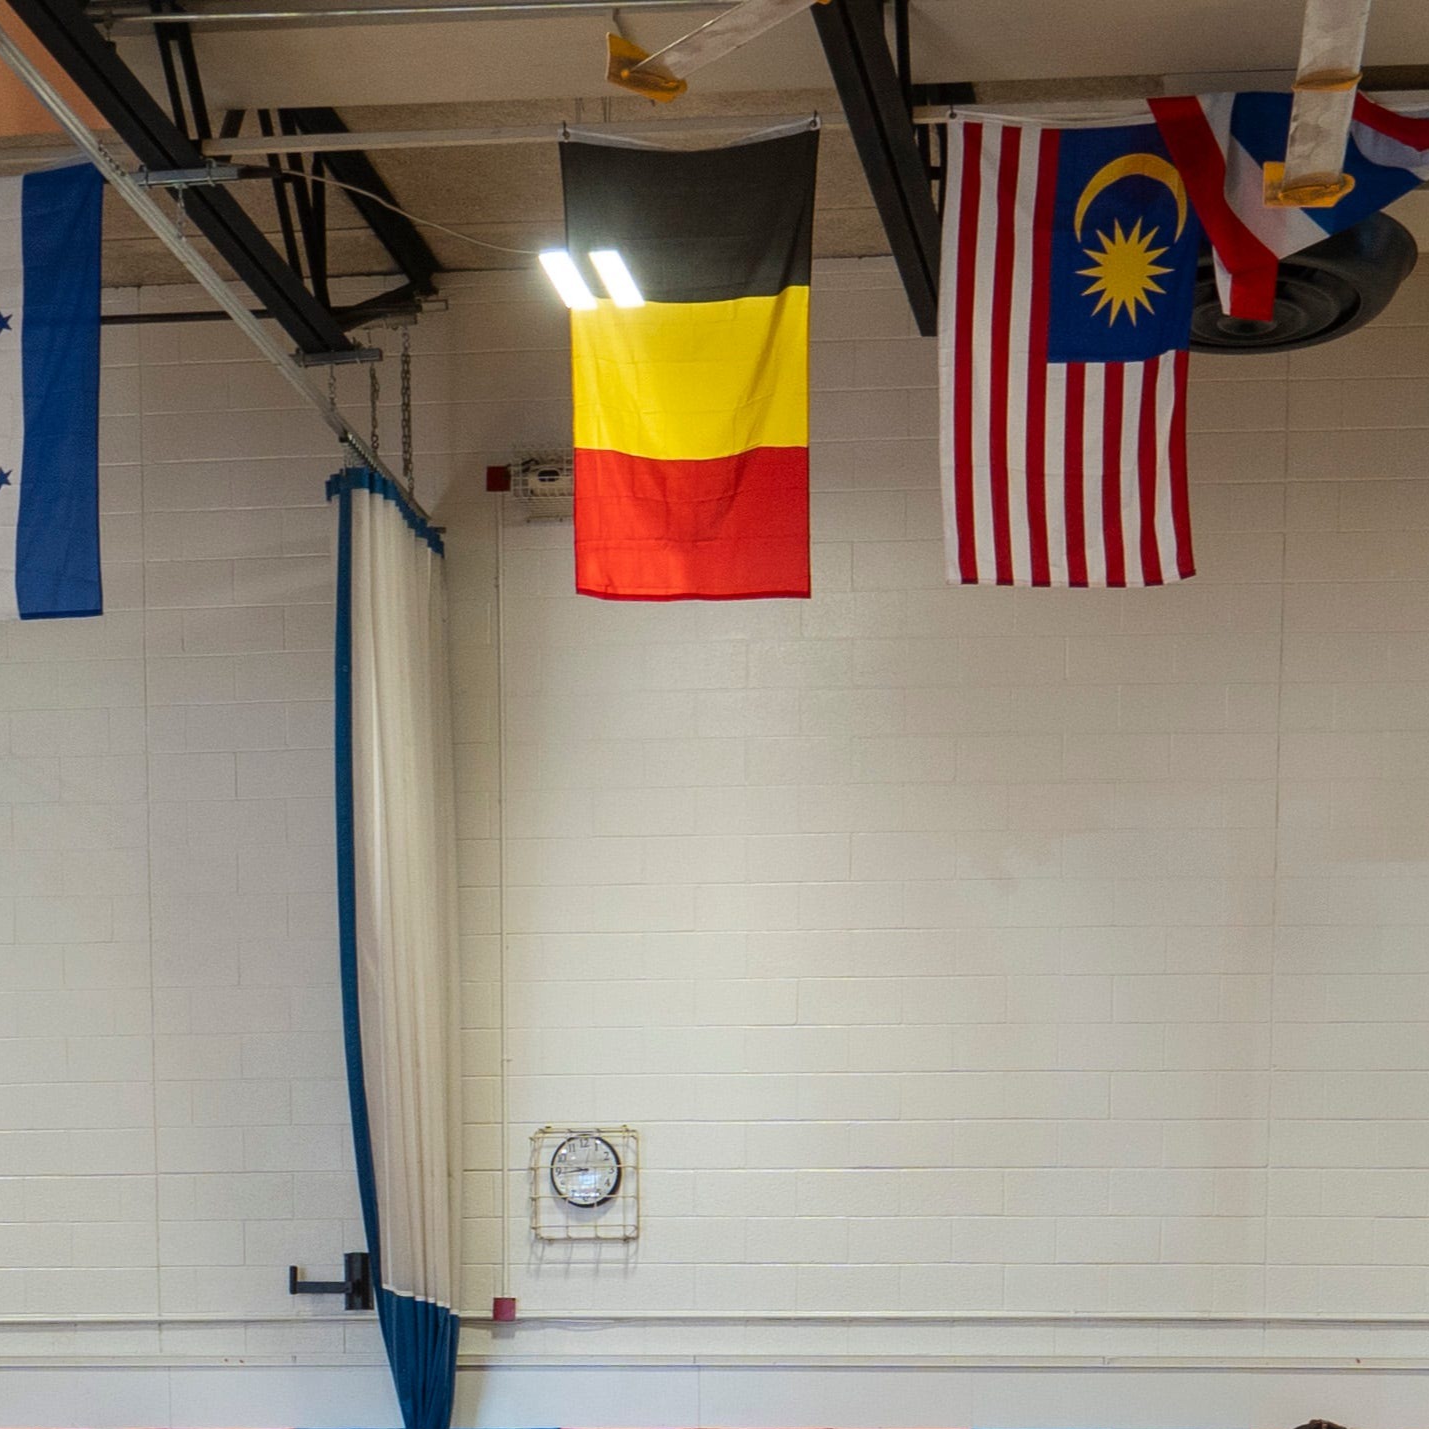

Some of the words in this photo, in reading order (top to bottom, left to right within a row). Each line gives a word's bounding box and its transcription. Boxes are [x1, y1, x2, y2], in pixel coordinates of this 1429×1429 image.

[568, 1143, 576, 1153] 11
[579, 1138, 590, 1148] 12
[603, 1151, 610, 1161] 2
[555, 1167, 562, 1176] 9
[604, 1178, 611, 1187] 4
